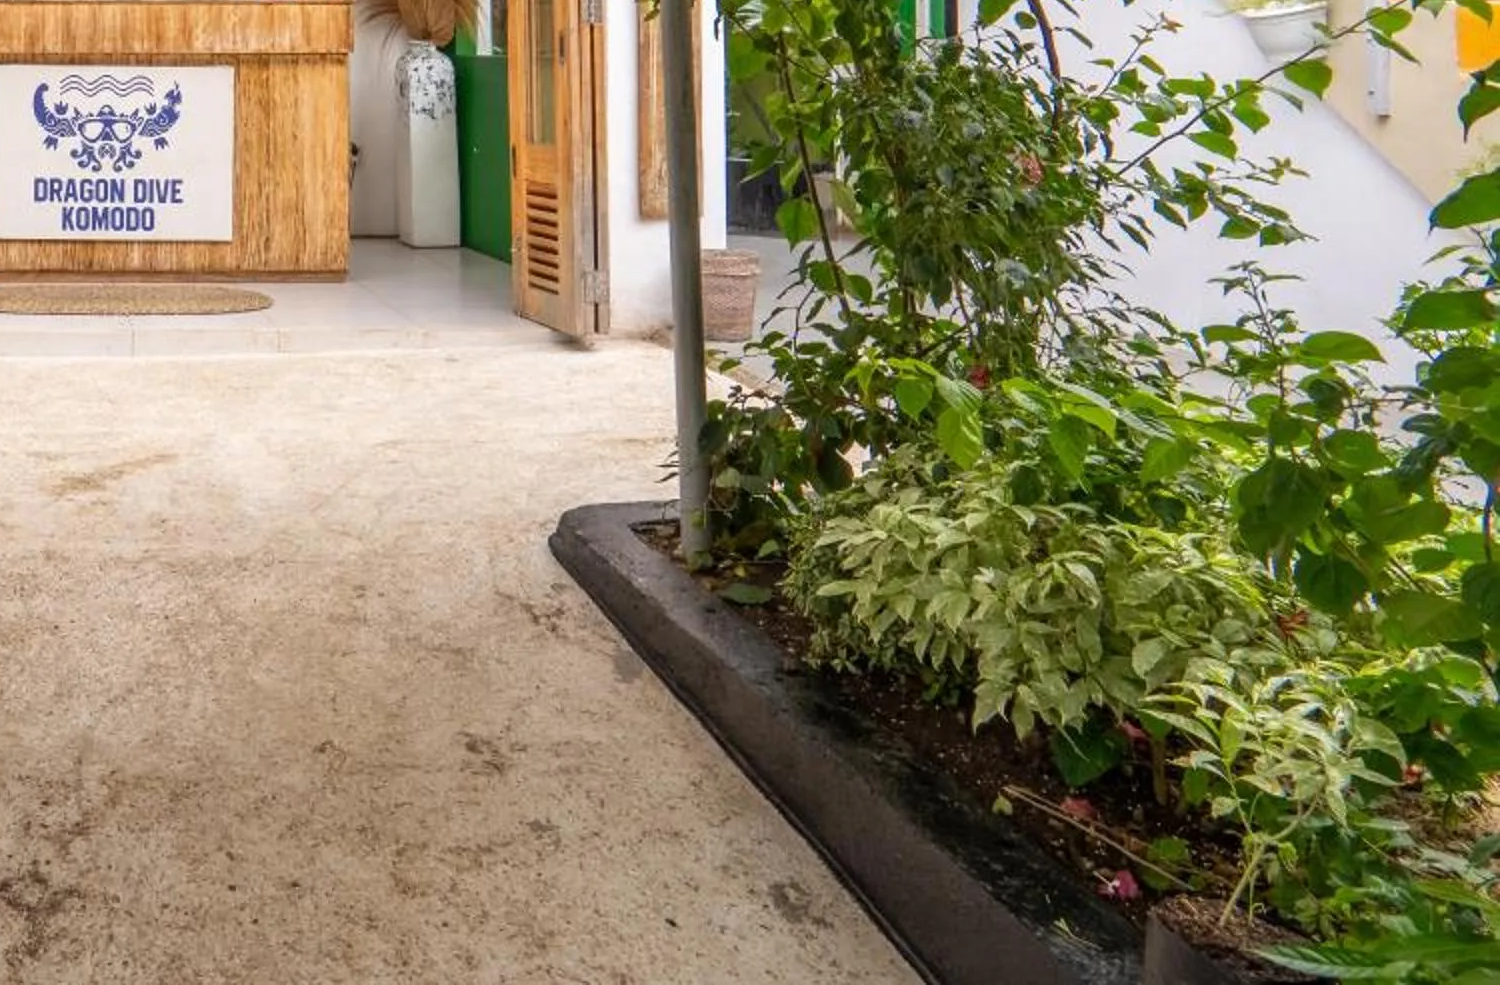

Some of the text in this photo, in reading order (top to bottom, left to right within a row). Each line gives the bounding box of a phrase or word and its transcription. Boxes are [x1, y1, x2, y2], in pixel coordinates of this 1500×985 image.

[33, 178, 184, 204] DRAGON DIVE
[61, 206, 156, 232] KOMODO
